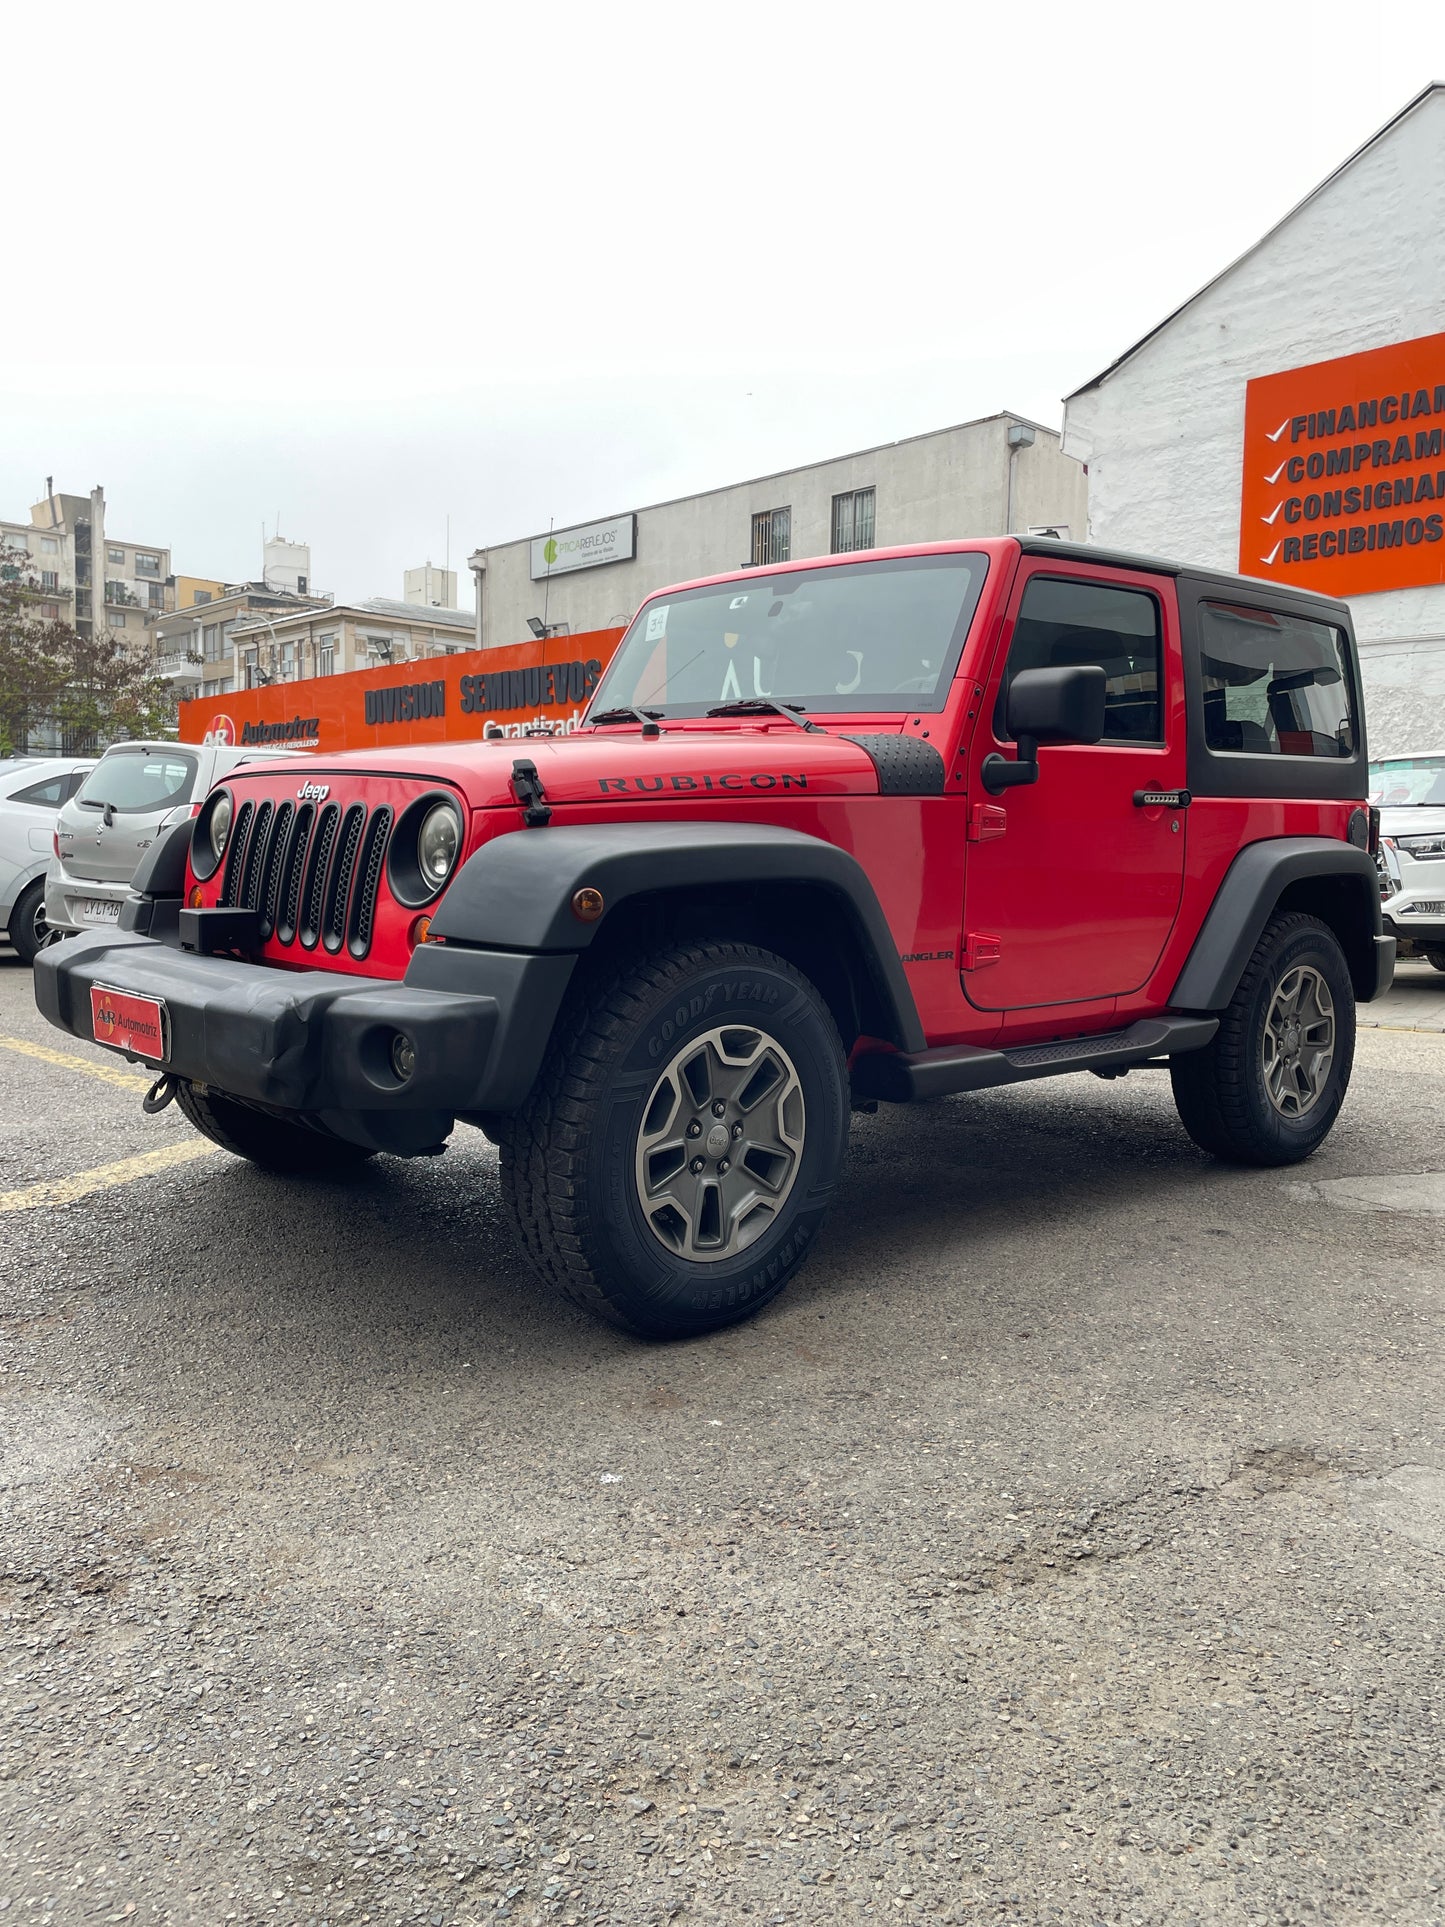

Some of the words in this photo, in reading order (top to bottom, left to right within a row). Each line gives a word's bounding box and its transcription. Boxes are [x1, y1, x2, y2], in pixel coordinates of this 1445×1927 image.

[1287, 428, 1445, 483] COMPRAM
[1283, 514, 1444, 563] RECIBIMOS
[364, 680, 446, 725] DIVISION
[460, 659, 602, 713] SEMINUEVOS
[241, 715, 320, 745] Automotriz
[483, 709, 579, 739] Grantizad
[297, 780, 330, 804] Jeep
[598, 773, 807, 793] RUBICON
[901, 951, 954, 962] ANGLER
[118, 1013, 157, 1038] Automotriz
